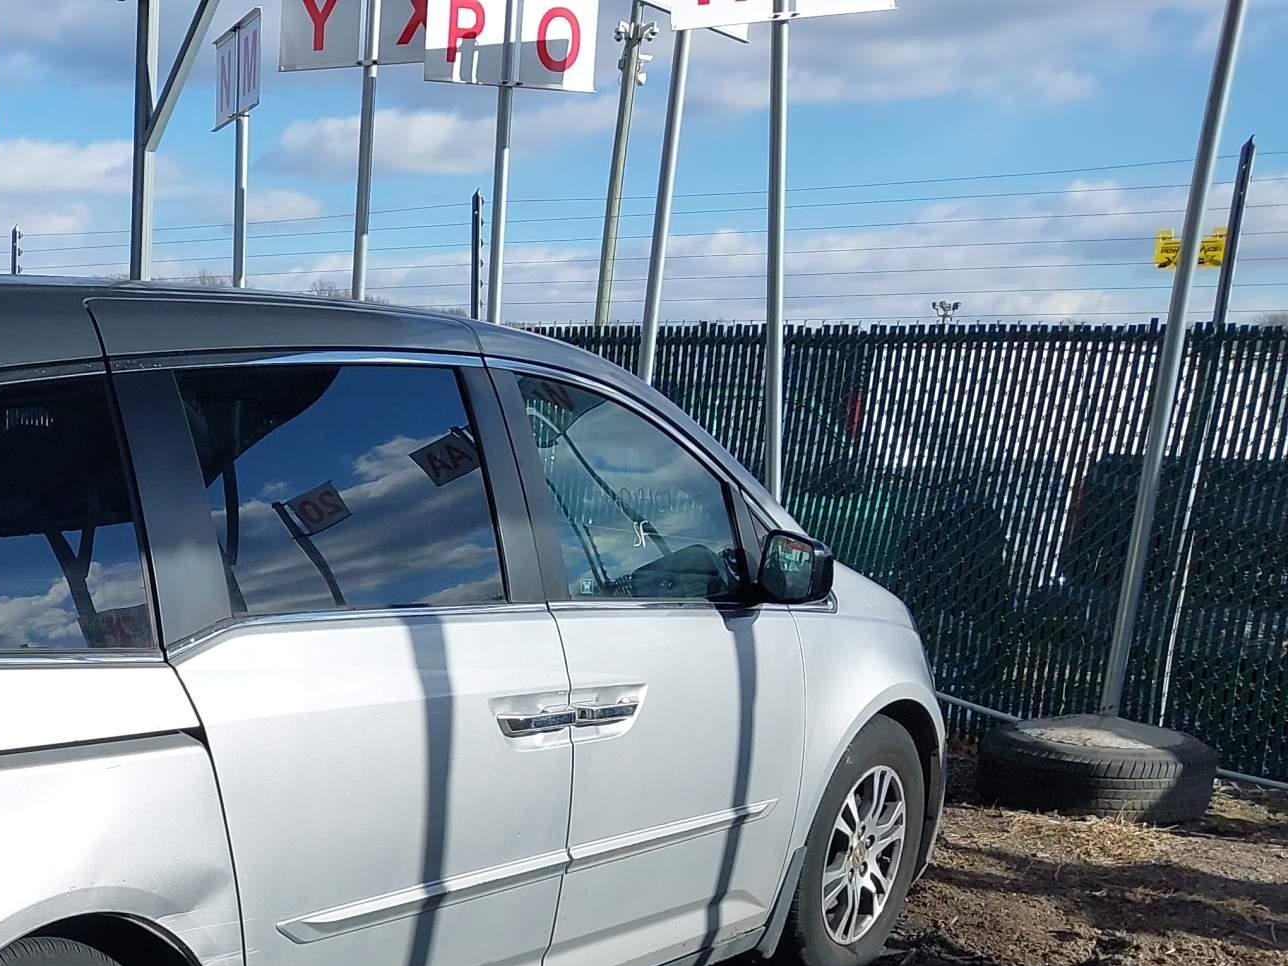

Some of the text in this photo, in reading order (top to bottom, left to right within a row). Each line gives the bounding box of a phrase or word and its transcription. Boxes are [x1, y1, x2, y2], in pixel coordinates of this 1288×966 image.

[302, 0, 337, 51] Y
[446, 0, 485, 62] P
[220, 28, 257, 112] N M
